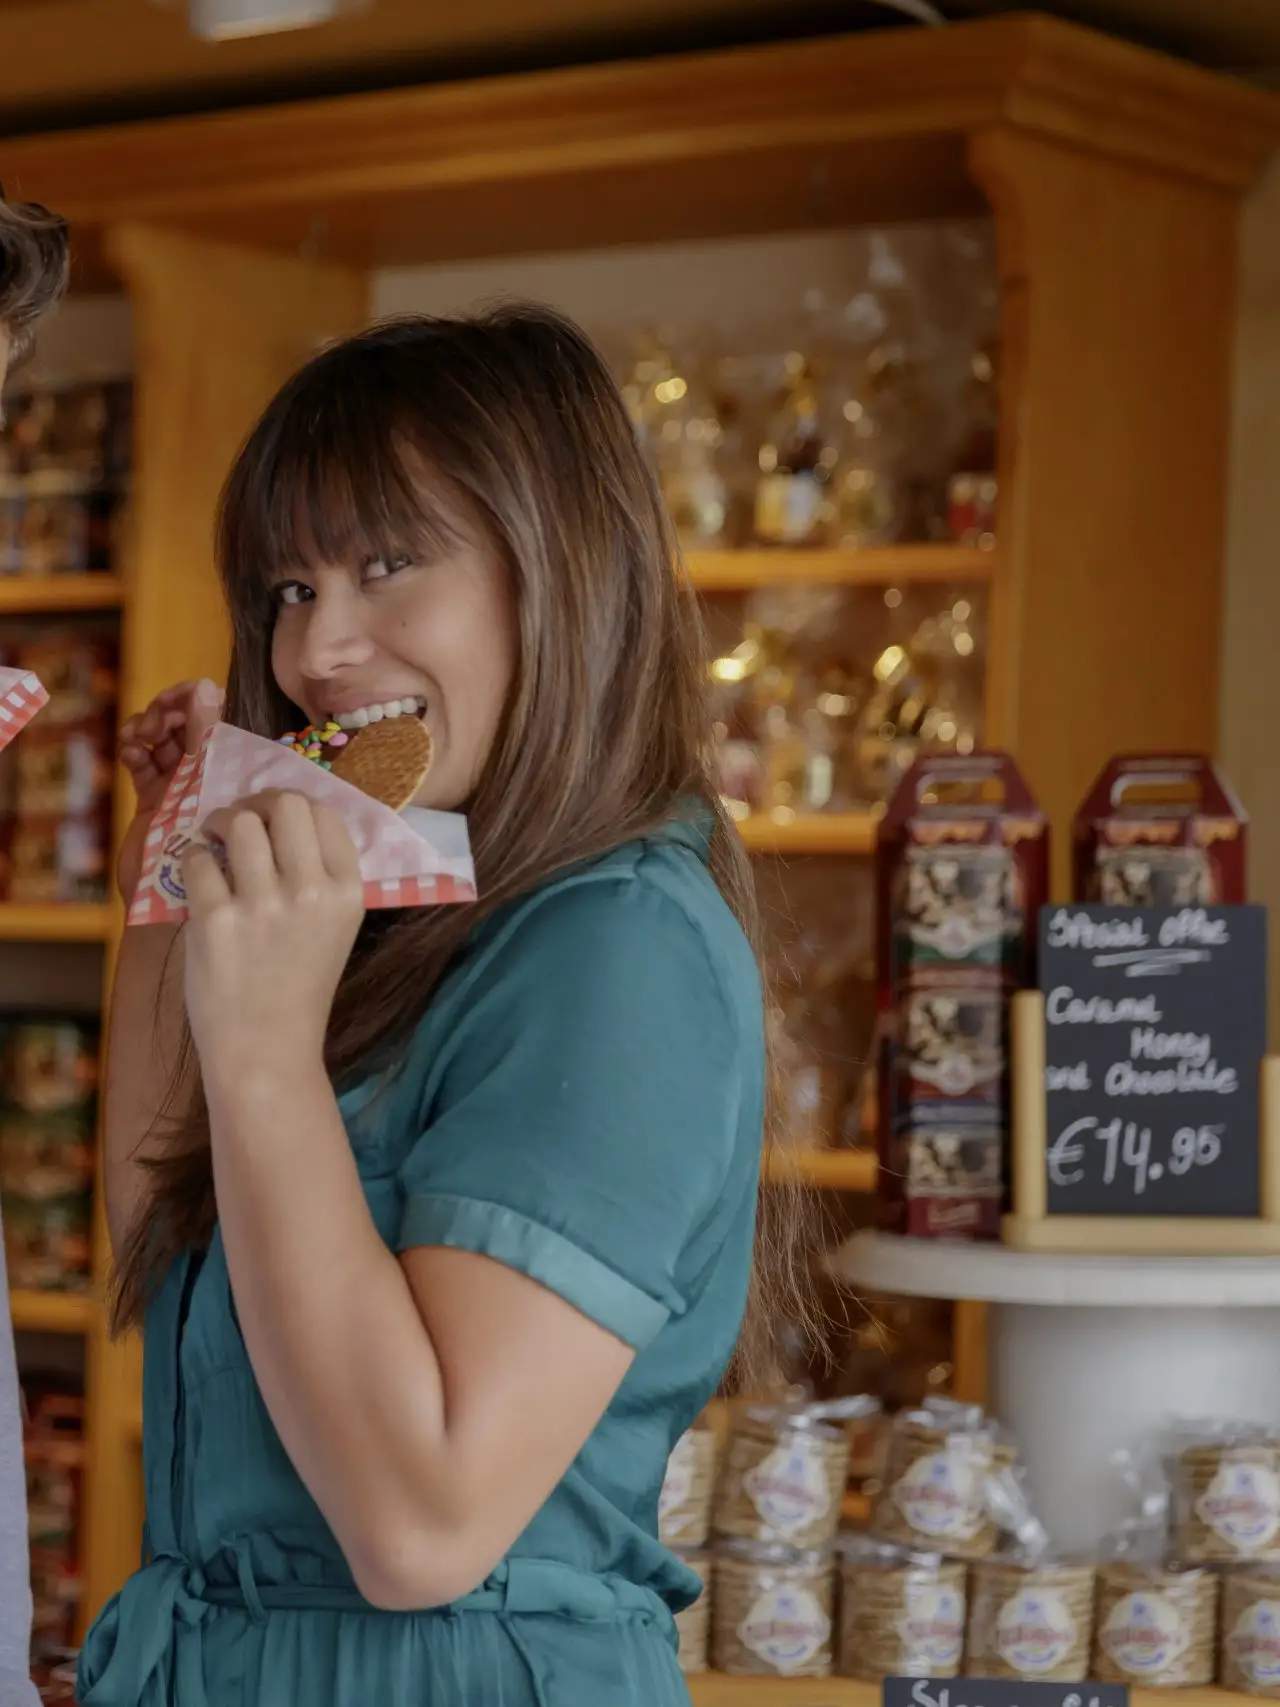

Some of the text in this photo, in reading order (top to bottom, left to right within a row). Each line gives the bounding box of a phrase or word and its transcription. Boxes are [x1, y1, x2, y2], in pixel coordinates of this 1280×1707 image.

[1130, 1027, 1211, 1067] Honey
[1104, 1059, 1239, 1096] Chocolate
[1046, 1116, 1226, 1195] €14.95
